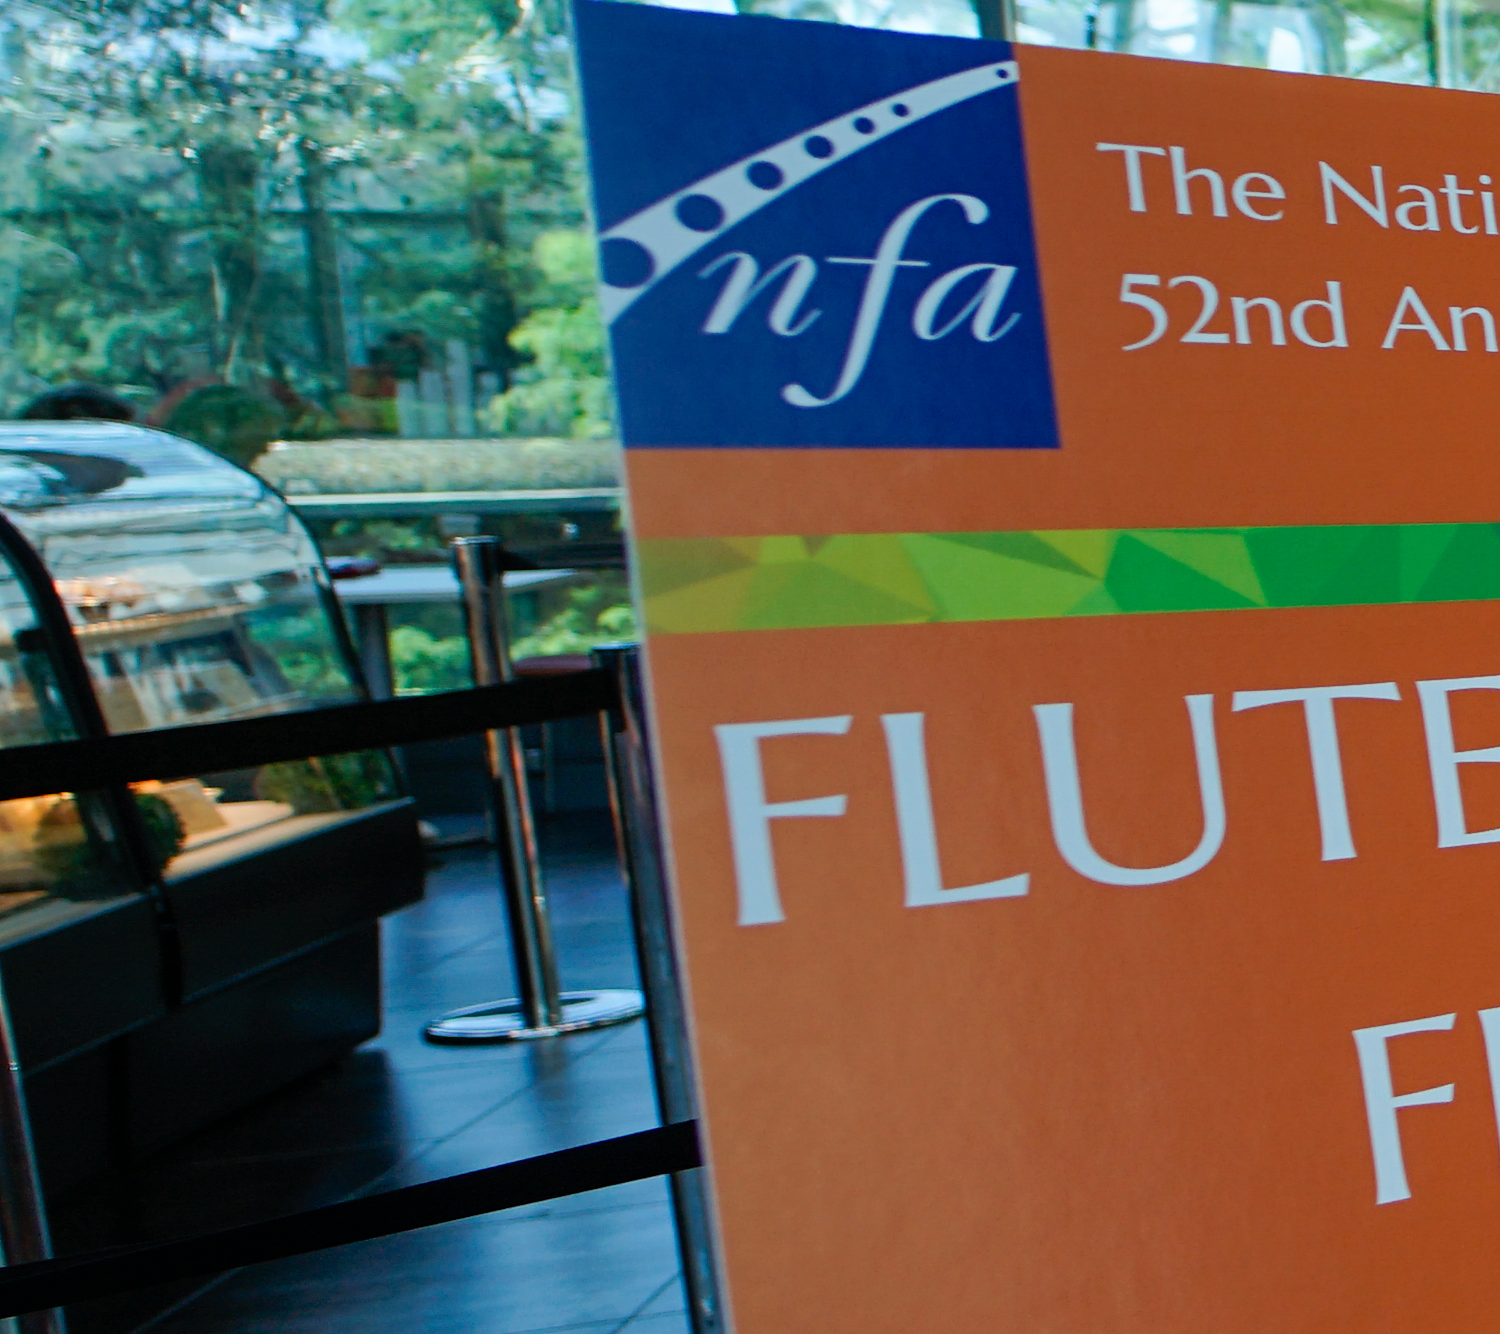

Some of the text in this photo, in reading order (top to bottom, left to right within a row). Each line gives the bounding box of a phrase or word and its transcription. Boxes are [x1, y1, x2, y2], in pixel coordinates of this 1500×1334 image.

[1096, 143, 1285, 222] The
[703, 193, 1021, 408] nfa
[1120, 274, 1348, 351] 52nd
